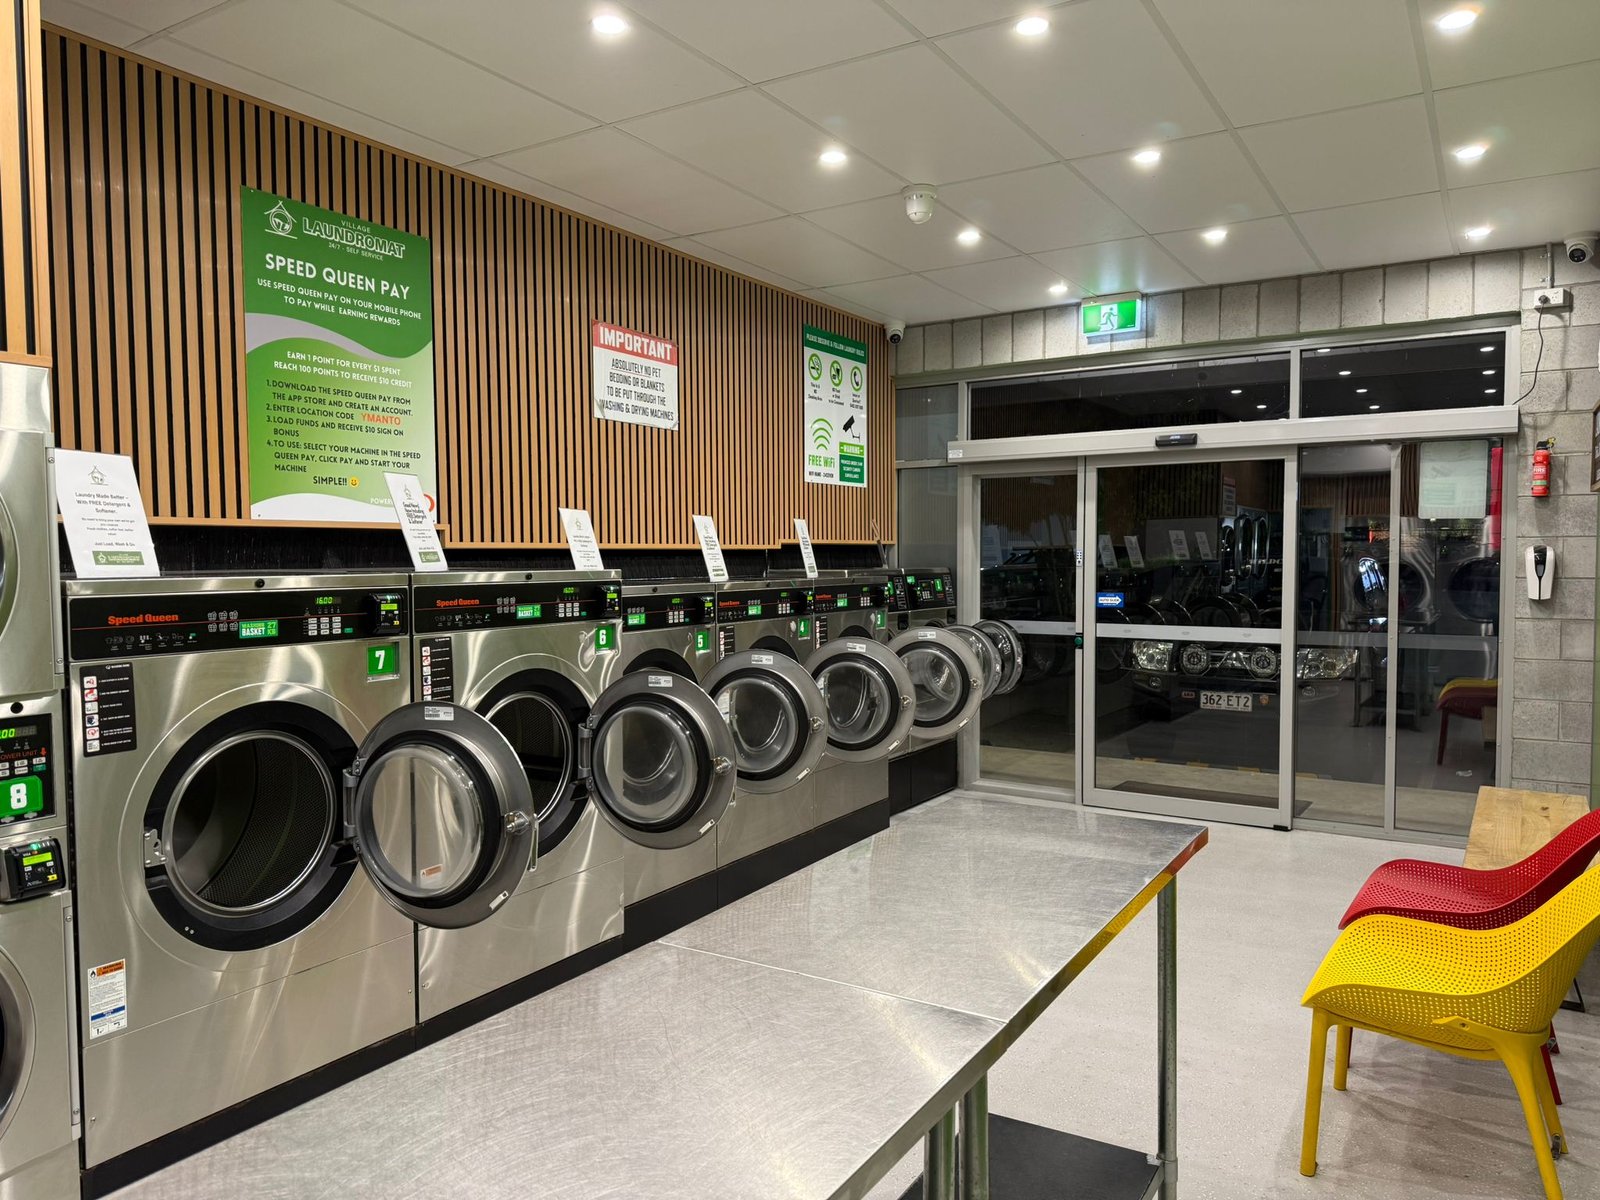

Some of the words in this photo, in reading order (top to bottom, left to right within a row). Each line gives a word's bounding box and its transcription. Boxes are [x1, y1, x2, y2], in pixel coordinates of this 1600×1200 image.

[341, 220, 371, 233] VILLAGE
[303, 217, 405, 258] LAUNDROMAT
[346, 246, 359, 255] SELF
[362, 250, 383, 261] SERVICE
[265, 253, 316, 279] SPEED
[322, 267, 375, 293] QUEEN
[381, 281, 410, 300] PAY
[258, 278, 271, 288] USE
[274, 281, 296, 293] SPEED
[298, 287, 322, 299] QUEEN
[324, 293, 338, 302] PAY
[340, 296, 351, 304] ON
[353, 299, 373, 310] YOUR
[374, 303, 398, 315] MOBILE
[400, 309, 421, 320] PHONE
[284, 296, 295, 304] TO
[297, 299, 312, 308] PAY
[314, 302, 334, 313] WHILE
[339, 307, 368, 320] EARNING
[370, 313, 400, 326] REWARDS
[600, 327, 672, 360] IMPORTANT
[287, 351, 306, 361] EARN
[313, 356, 334, 365] POINT
[337, 359, 350, 368] FOR
[352, 362, 372, 371] EVERY
[374, 365, 380, 373] $1
[382, 366, 400, 375] SPENT
[612, 358, 644, 374] ABSOLUTELY
[644, 367, 651, 375] NO
[652, 368, 661, 378] PET
[274, 361, 297, 372] REACH
[299, 365, 311, 373] 100
[313, 367, 338, 377] POINTS
[340, 370, 350, 378] TO
[352, 372, 377, 383] RECEIVE
[391, 378, 412, 388] CREDIT
[610, 372, 631, 386] BEDDING
[633, 377, 639, 387] OR
[641, 379, 664, 392] BLANKETS
[272, 381, 316, 393] DOWNLOAD
[318, 386, 331, 394] THE
[333, 388, 353, 397] SPEED
[355, 391, 377, 401] QUEEN
[378, 394, 391, 403] PAY
[393, 396, 411, 405] FROM
[607, 386, 613, 396] TO
[615, 388, 621, 398] BE
[623, 389, 632, 399] PUT
[634, 391, 656, 404] THROUGH
[657, 396, 666, 406] THE
[272, 392, 286, 400] THE
[288, 394, 302, 403] APP
[304, 396, 326, 405] STORE
[328, 399, 343, 408] AND
[345, 401, 368, 411] CREATE
[382, 406, 413, 416] ACCOUNT.
[600, 399, 624, 412] WASHING
[626, 404, 630, 413] &
[632, 406, 649, 416] DRYING
[650, 409, 673, 420] MACHINES
[273, 404, 295, 414] ENTER
[297, 407, 334, 418] LOCATION
[336, 411, 354, 420] CODE
[361, 412, 401, 425] YMANTO
[273, 416, 294, 425] LOAD
[296, 418, 318, 428] FUNDS
[321, 421, 335, 429] AND
[338, 423, 363, 433] RECEIVE
[365, 426, 376, 434] $10
[377, 427, 392, 435] SIGN
[393, 428, 403, 436] ON
[274, 428, 299, 437] BONUS
[274, 440, 285, 448] TO
[287, 441, 301, 450] USE:
[304, 443, 327, 452] SELECT
[329, 444, 349, 453] YOUR
[351, 447, 379, 456] MACHINE
[403, 450, 421, 459] SPEED
[274, 452, 299, 461] QUEEN
[301, 454, 316, 463] PAY,
[319, 455, 337, 464] CLICK
[371, 459, 390, 468] START
[392, 460, 410, 469] YOUR
[275, 463, 307, 473] MACHINE
[809, 455, 821, 466] FREE
[313, 475, 347, 486] SIMPLE!!
[436, 599, 457, 607] Speed
[108, 614, 143, 625] Speed
[145, 614, 178, 622] Queen
[242, 628, 265, 636] BASKET
[599, 629, 606, 645] 6
[698, 635, 703, 647] 5
[375, 650, 385, 669] 7
[10, 783, 27, 809] 8
